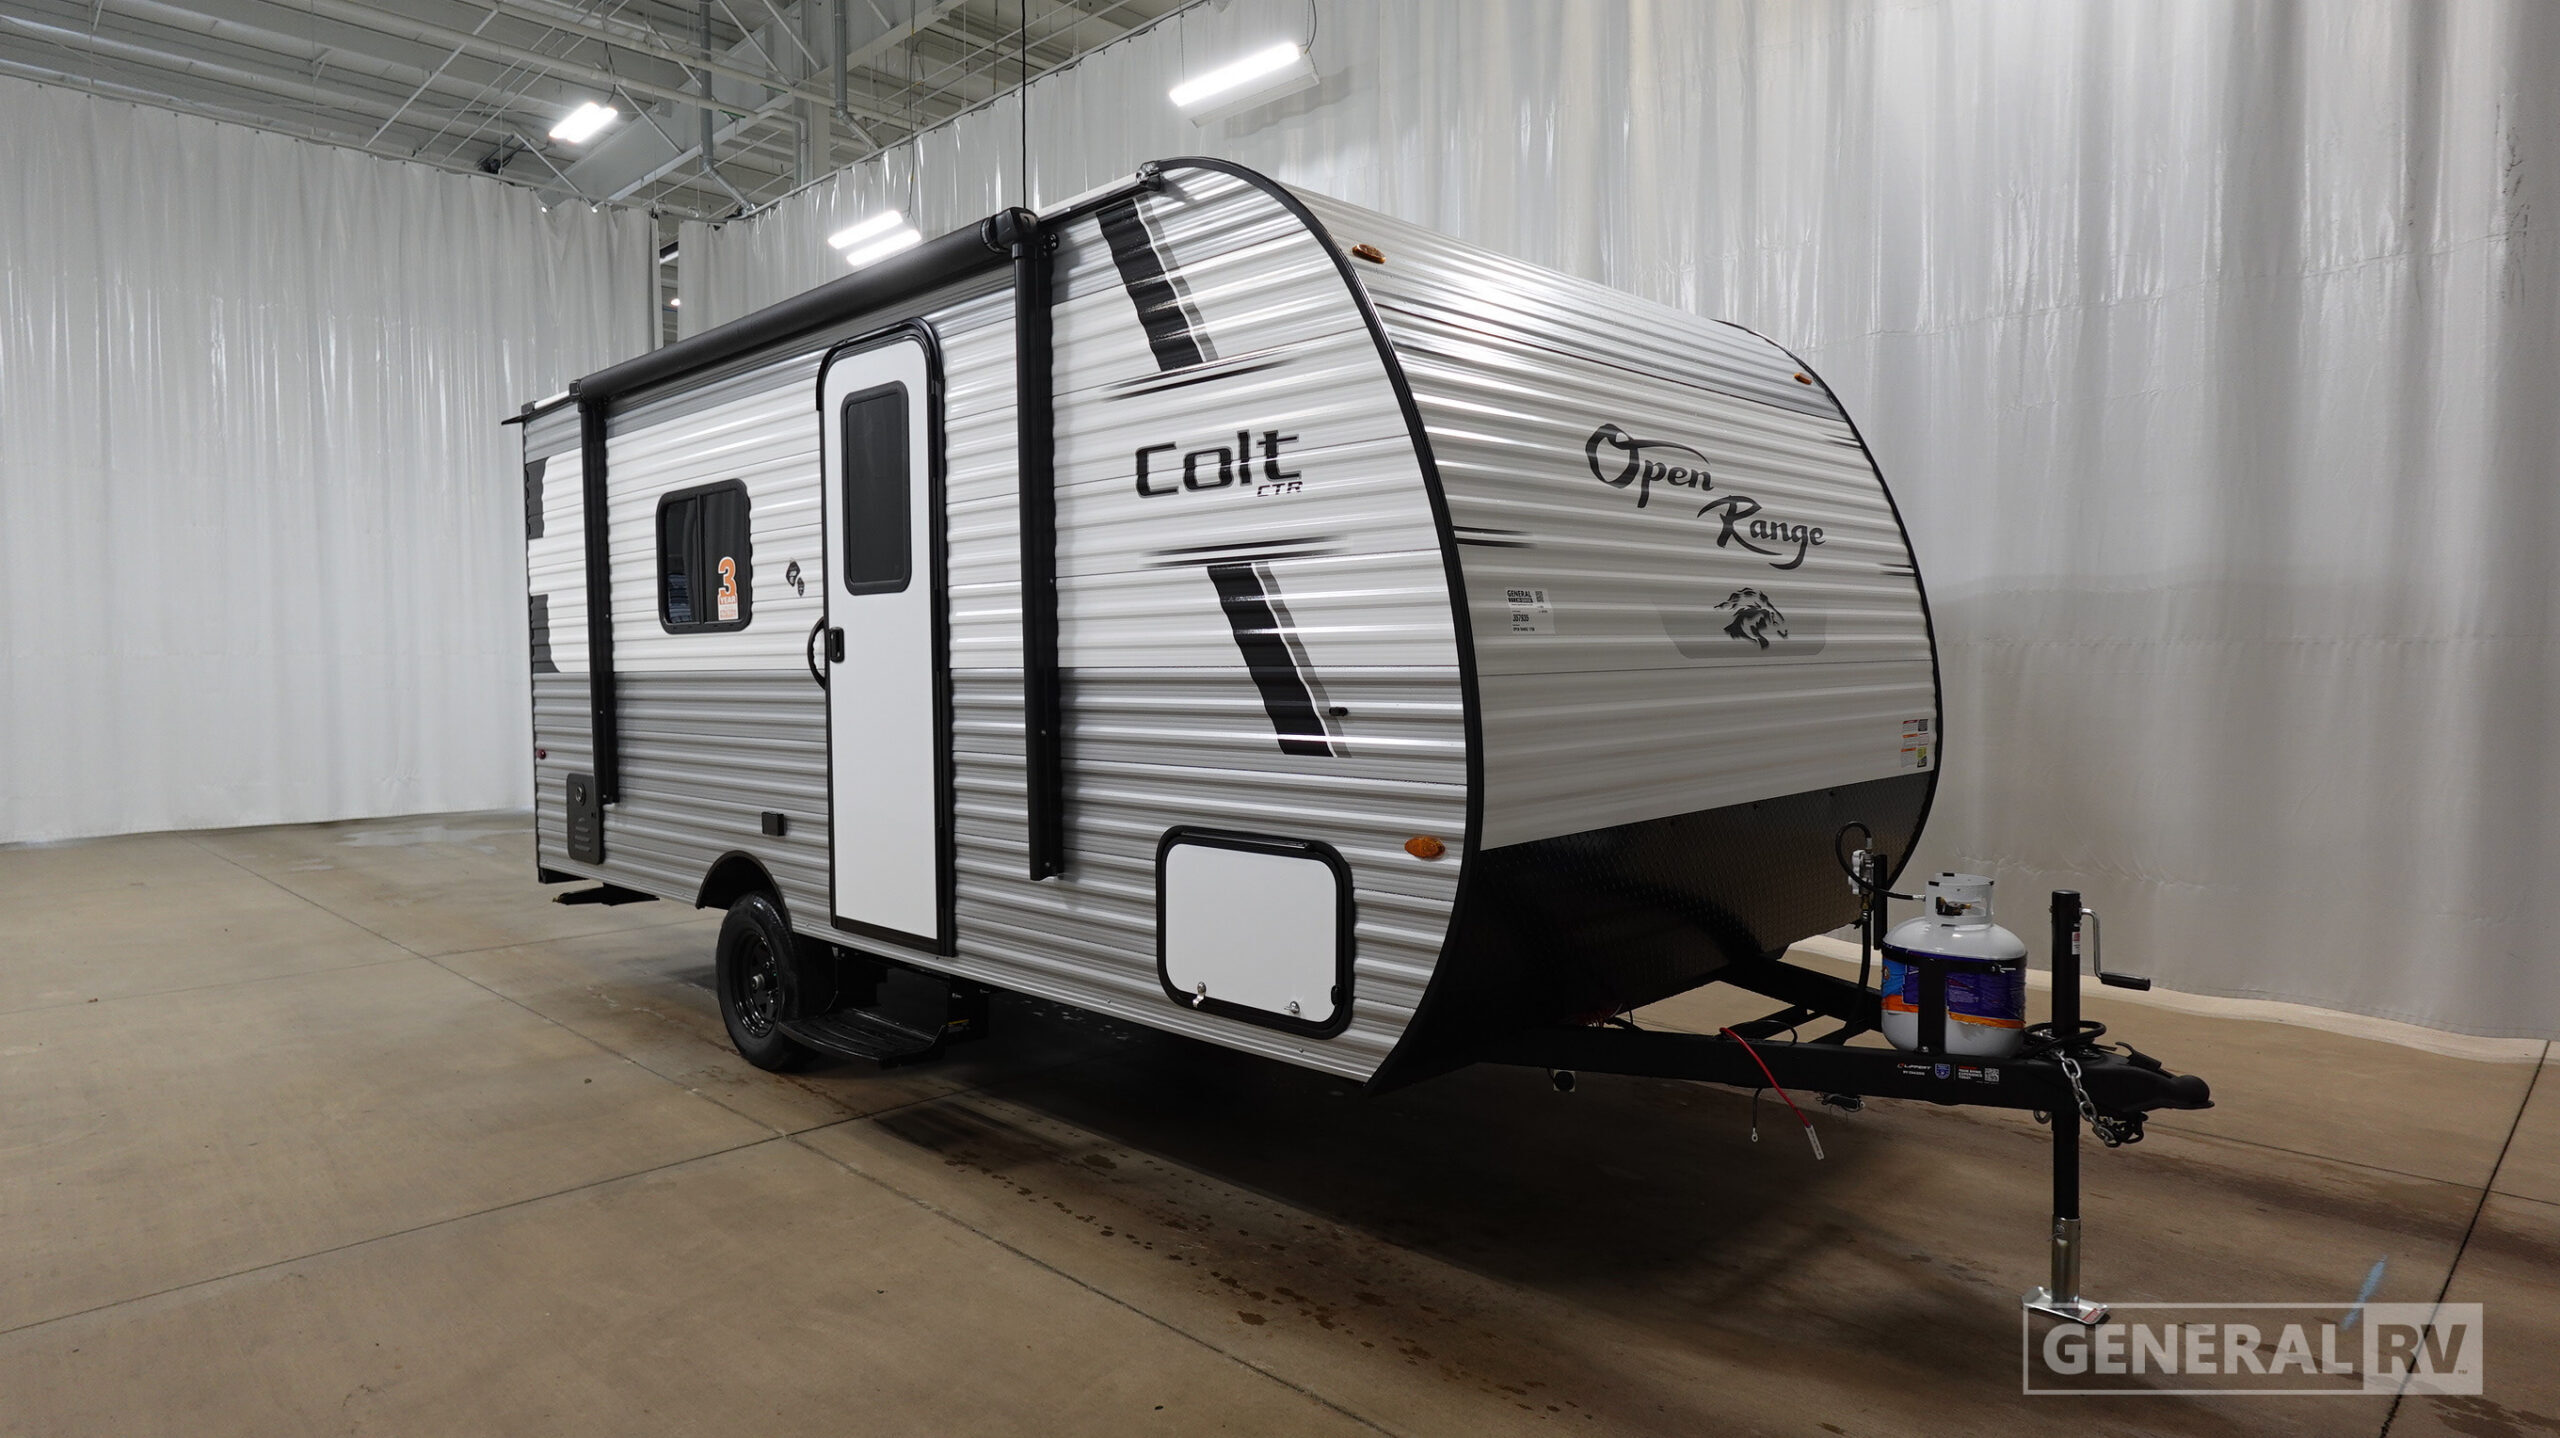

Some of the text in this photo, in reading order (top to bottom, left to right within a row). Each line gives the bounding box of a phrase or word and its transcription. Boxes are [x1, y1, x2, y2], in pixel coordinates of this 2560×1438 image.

[1135, 429, 1302, 498] Colt
[1257, 481, 1303, 497] CTR
[1585, 423, 1714, 508] Open
[1696, 495, 1826, 570] Range
[718, 556, 737, 597] 3
[1506, 589, 1532, 598] GENERAL
